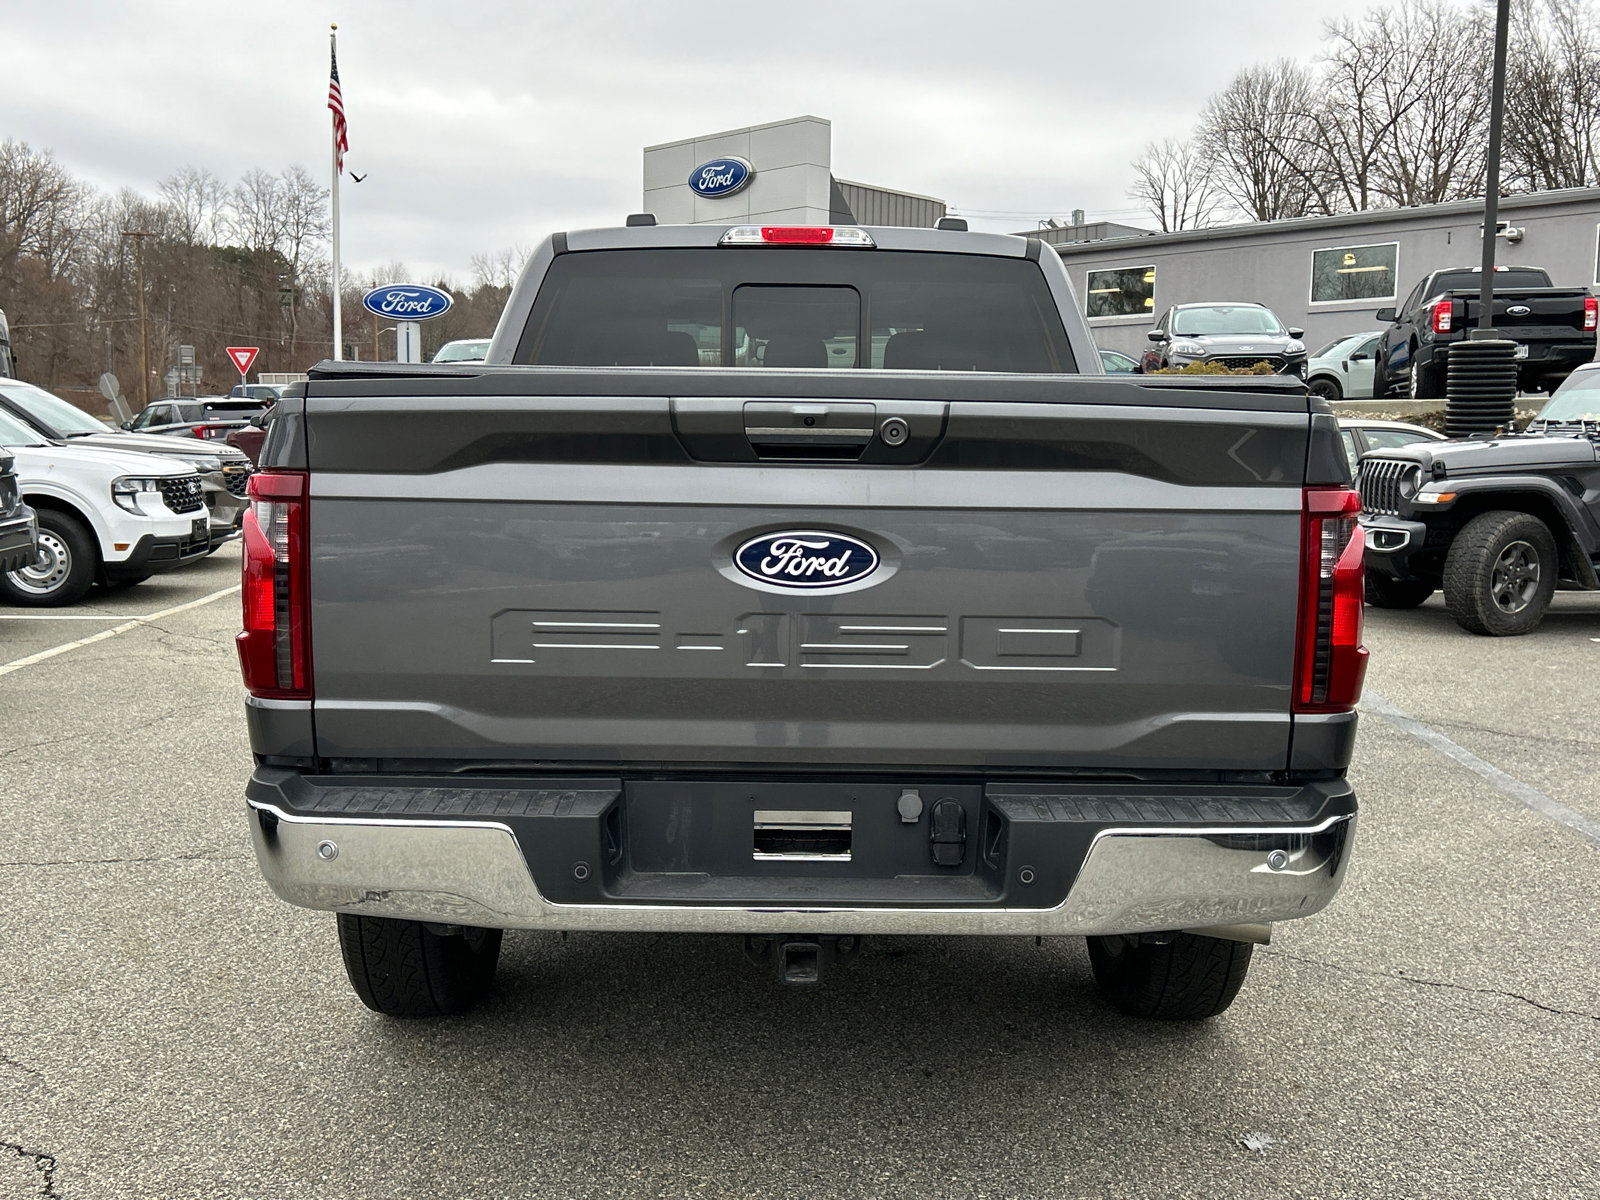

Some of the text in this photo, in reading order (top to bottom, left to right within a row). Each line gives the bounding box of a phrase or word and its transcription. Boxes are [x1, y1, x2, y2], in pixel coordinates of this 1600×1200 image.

[698, 164, 735, 190] Ford
[381, 291, 433, 312] Ford
[760, 538, 853, 577] Ford
[490, 608, 1121, 671] F-150
